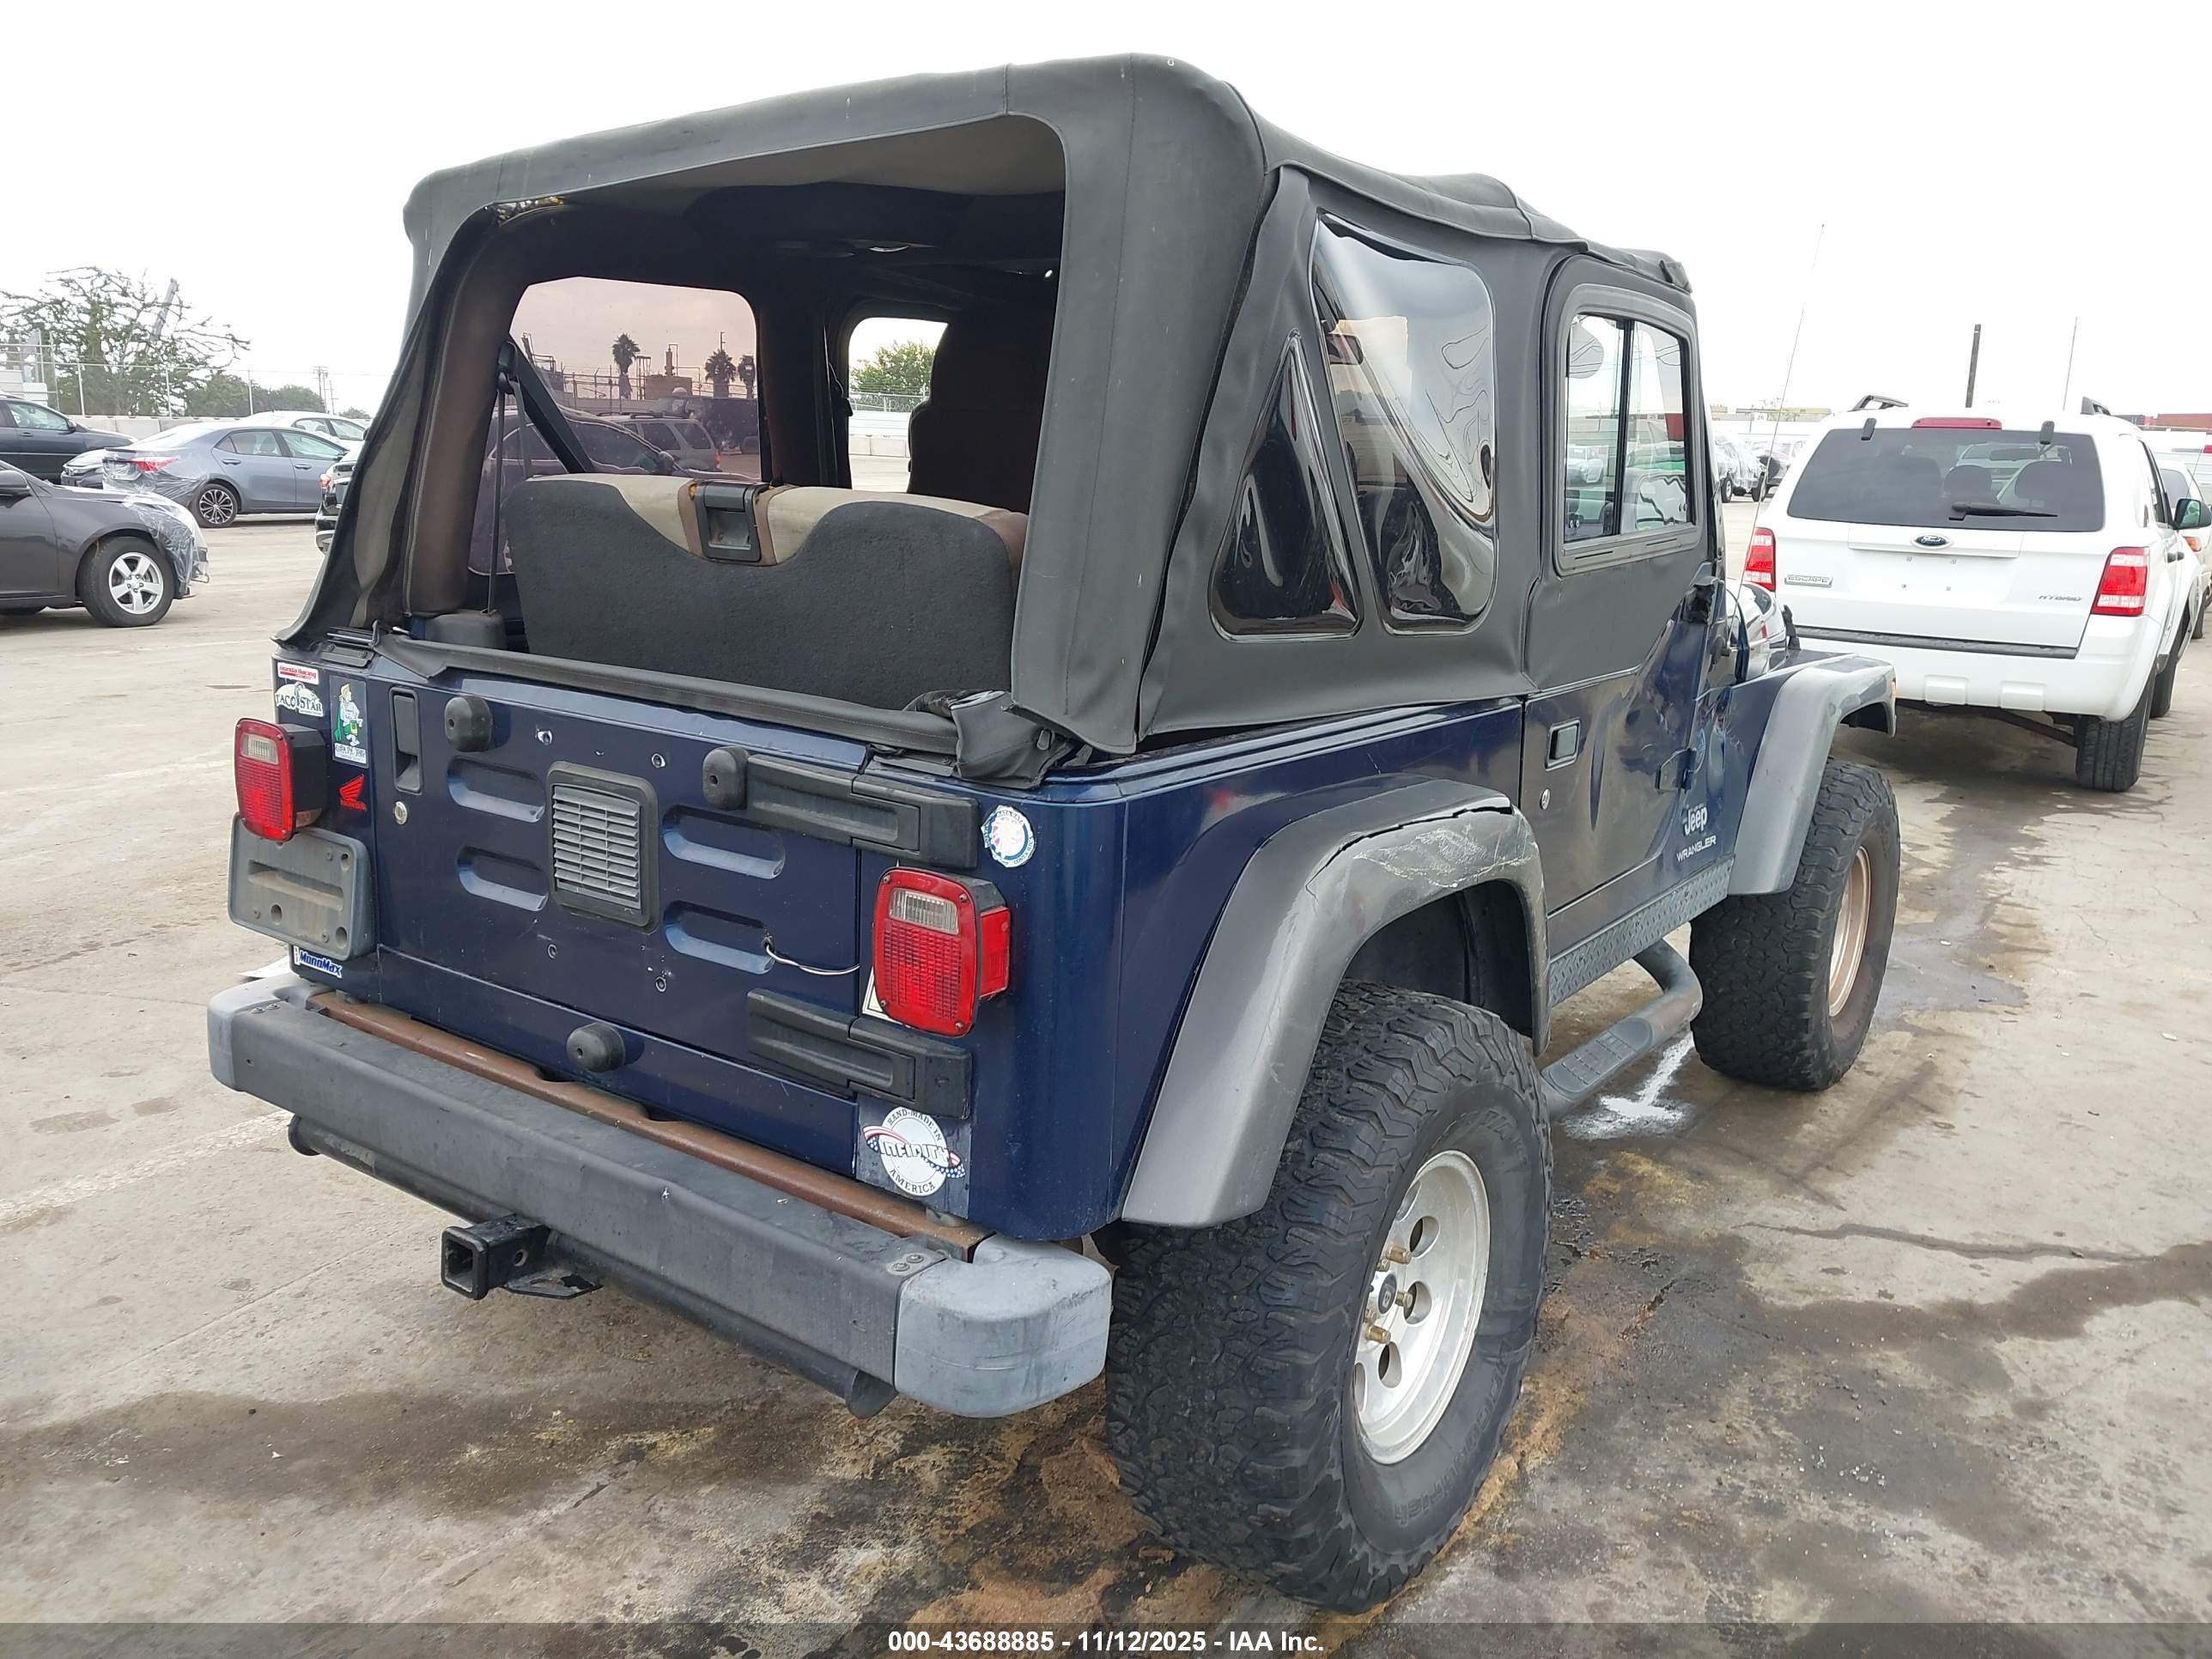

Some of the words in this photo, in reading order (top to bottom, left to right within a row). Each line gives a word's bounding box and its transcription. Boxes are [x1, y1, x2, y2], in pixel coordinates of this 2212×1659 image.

[275, 694, 296, 708] TACO
[300, 696, 322, 712] STAR
[1684, 806, 1708, 836] Jeep
[1676, 835, 1717, 863] WRANGLER
[300, 950, 342, 977] MonoMax
[887, 1109, 934, 1128] HAND-MADE
[933, 1127, 943, 1142] IN
[889, 1168, 936, 1194] AMERICA
